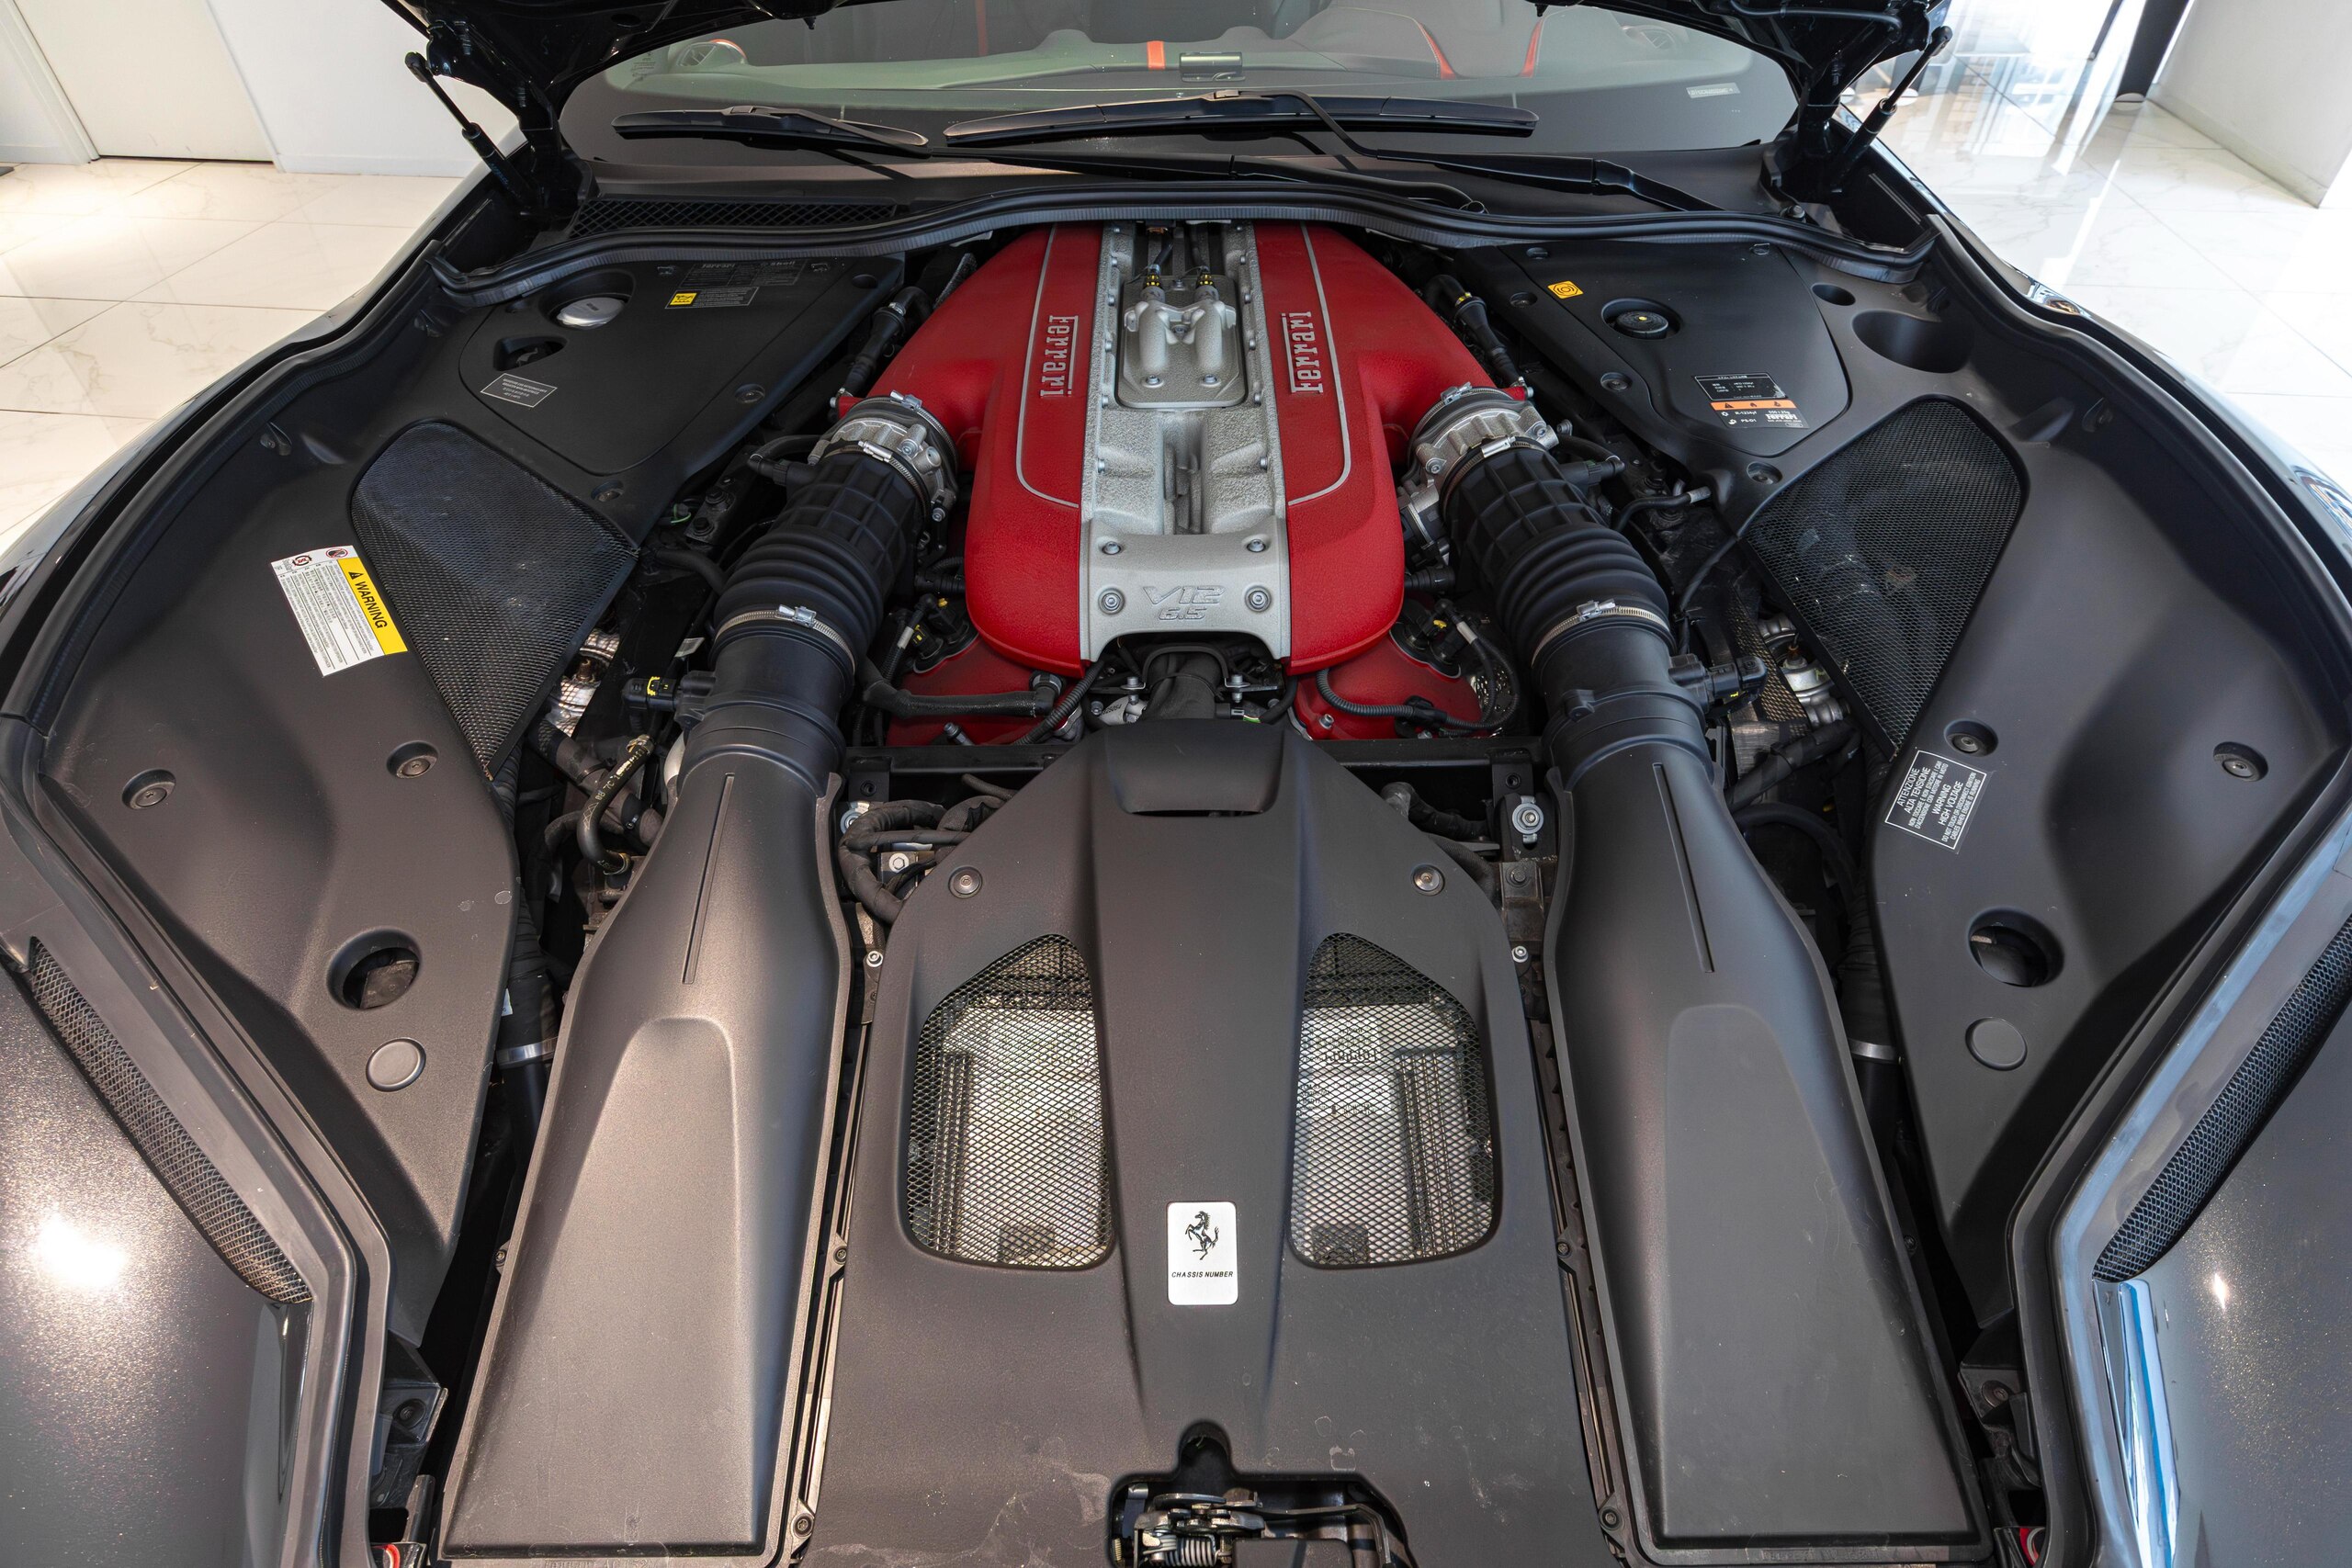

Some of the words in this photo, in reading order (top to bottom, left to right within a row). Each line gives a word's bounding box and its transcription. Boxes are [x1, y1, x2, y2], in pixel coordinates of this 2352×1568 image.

[1039, 315, 1079, 397] Ferrari
[1281, 311, 1324, 393] Ferrari
[355, 581, 388, 629] WARNING
[1142, 585, 1227, 605] V12
[1158, 606, 1207, 621] 6.5
[1896, 767, 1919, 806] ATTENZIONE
[1904, 797, 1916, 813] ALTA
[1911, 766, 1930, 798] TENSIONE
[1932, 784, 1951, 815] WARNING
[1938, 807, 1951, 825] HIGH
[1945, 781, 1963, 808] VOLTAGE
